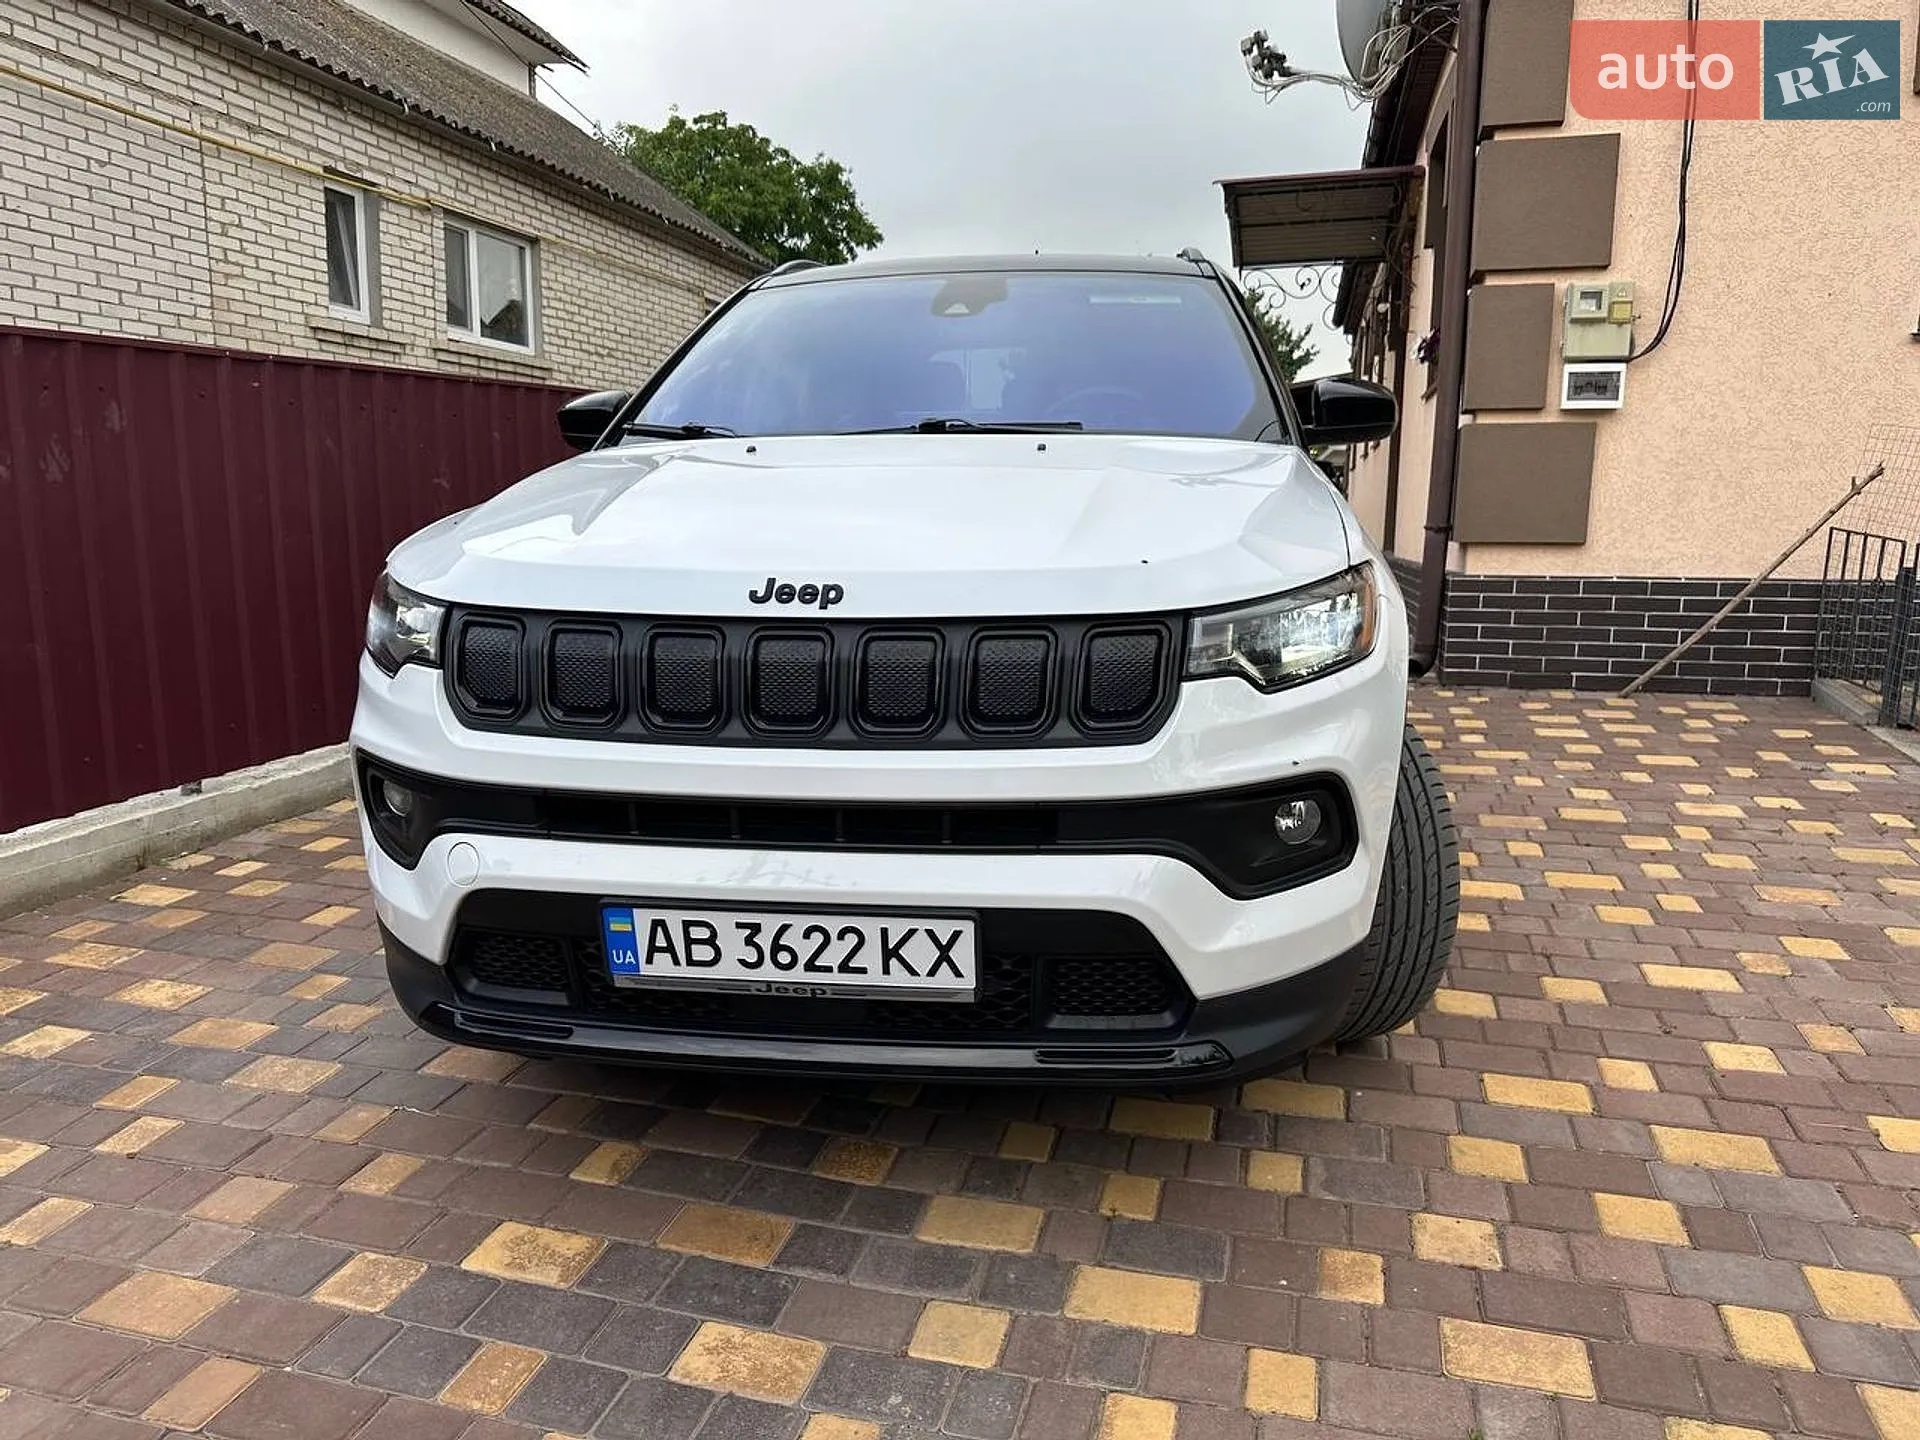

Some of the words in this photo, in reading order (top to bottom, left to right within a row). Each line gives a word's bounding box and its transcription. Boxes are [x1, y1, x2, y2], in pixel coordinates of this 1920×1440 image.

[748, 577, 844, 610] Jeep
[613, 950, 636, 965] UA
[645, 918, 723, 968] AB
[735, 921, 868, 975] 3622
[880, 926, 965, 979] KX
[754, 983, 827, 999] Jeep
